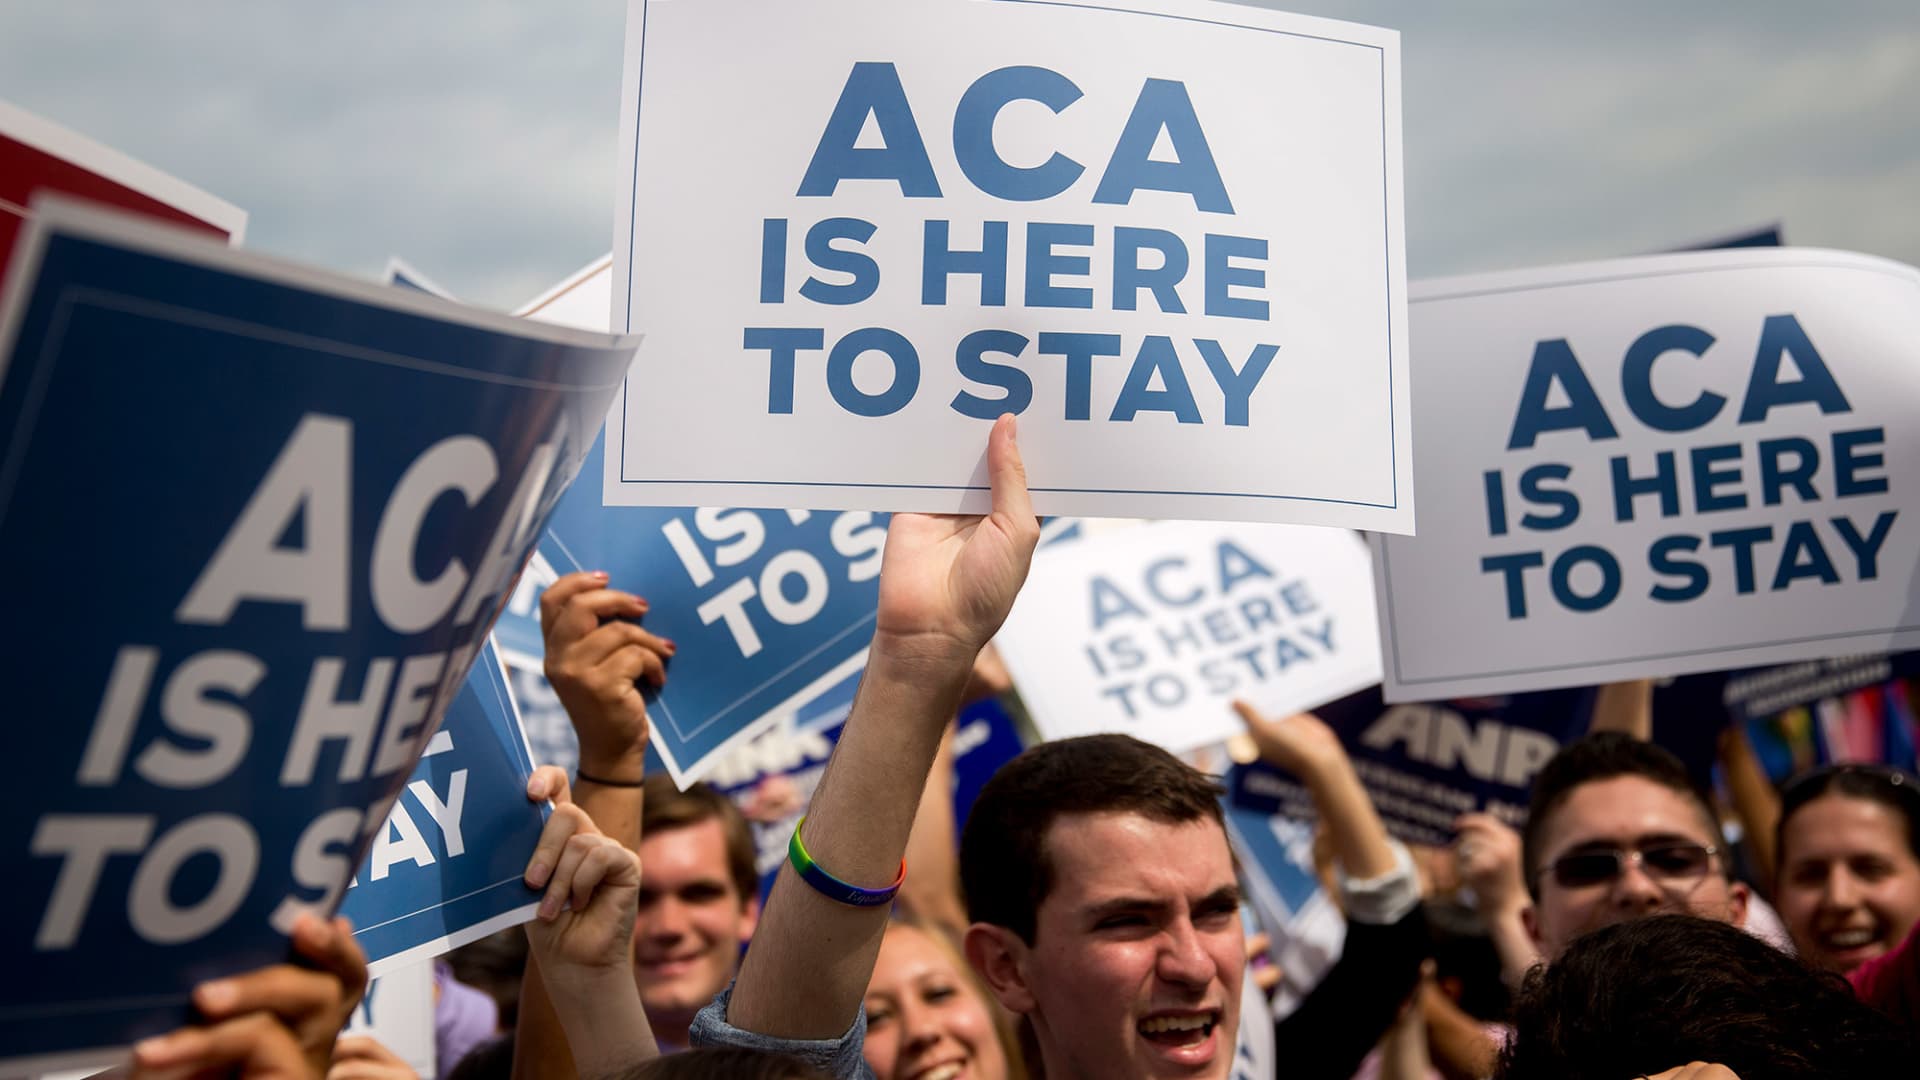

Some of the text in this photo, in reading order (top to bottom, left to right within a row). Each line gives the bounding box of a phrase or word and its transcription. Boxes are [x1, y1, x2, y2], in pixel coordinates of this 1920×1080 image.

[796, 62, 1235, 215] ACA
[760, 217, 1269, 321] IS HERE
[744, 327, 1280, 426] TO STAY
[1507, 315, 1852, 450] ACA
[1484, 427, 1889, 536] IS HERE
[662, 507, 766, 587] IS
[1088, 540, 1275, 630] ACA
[1482, 510, 1899, 619] TO STAY
[697, 550, 829, 659] TO
[1085, 581, 1320, 676] IS HERE
[76, 645, 267, 788] IS
[1103, 619, 1340, 719] TO STAY
[29, 813, 260, 950] TO
[349, 769, 467, 888] AY
